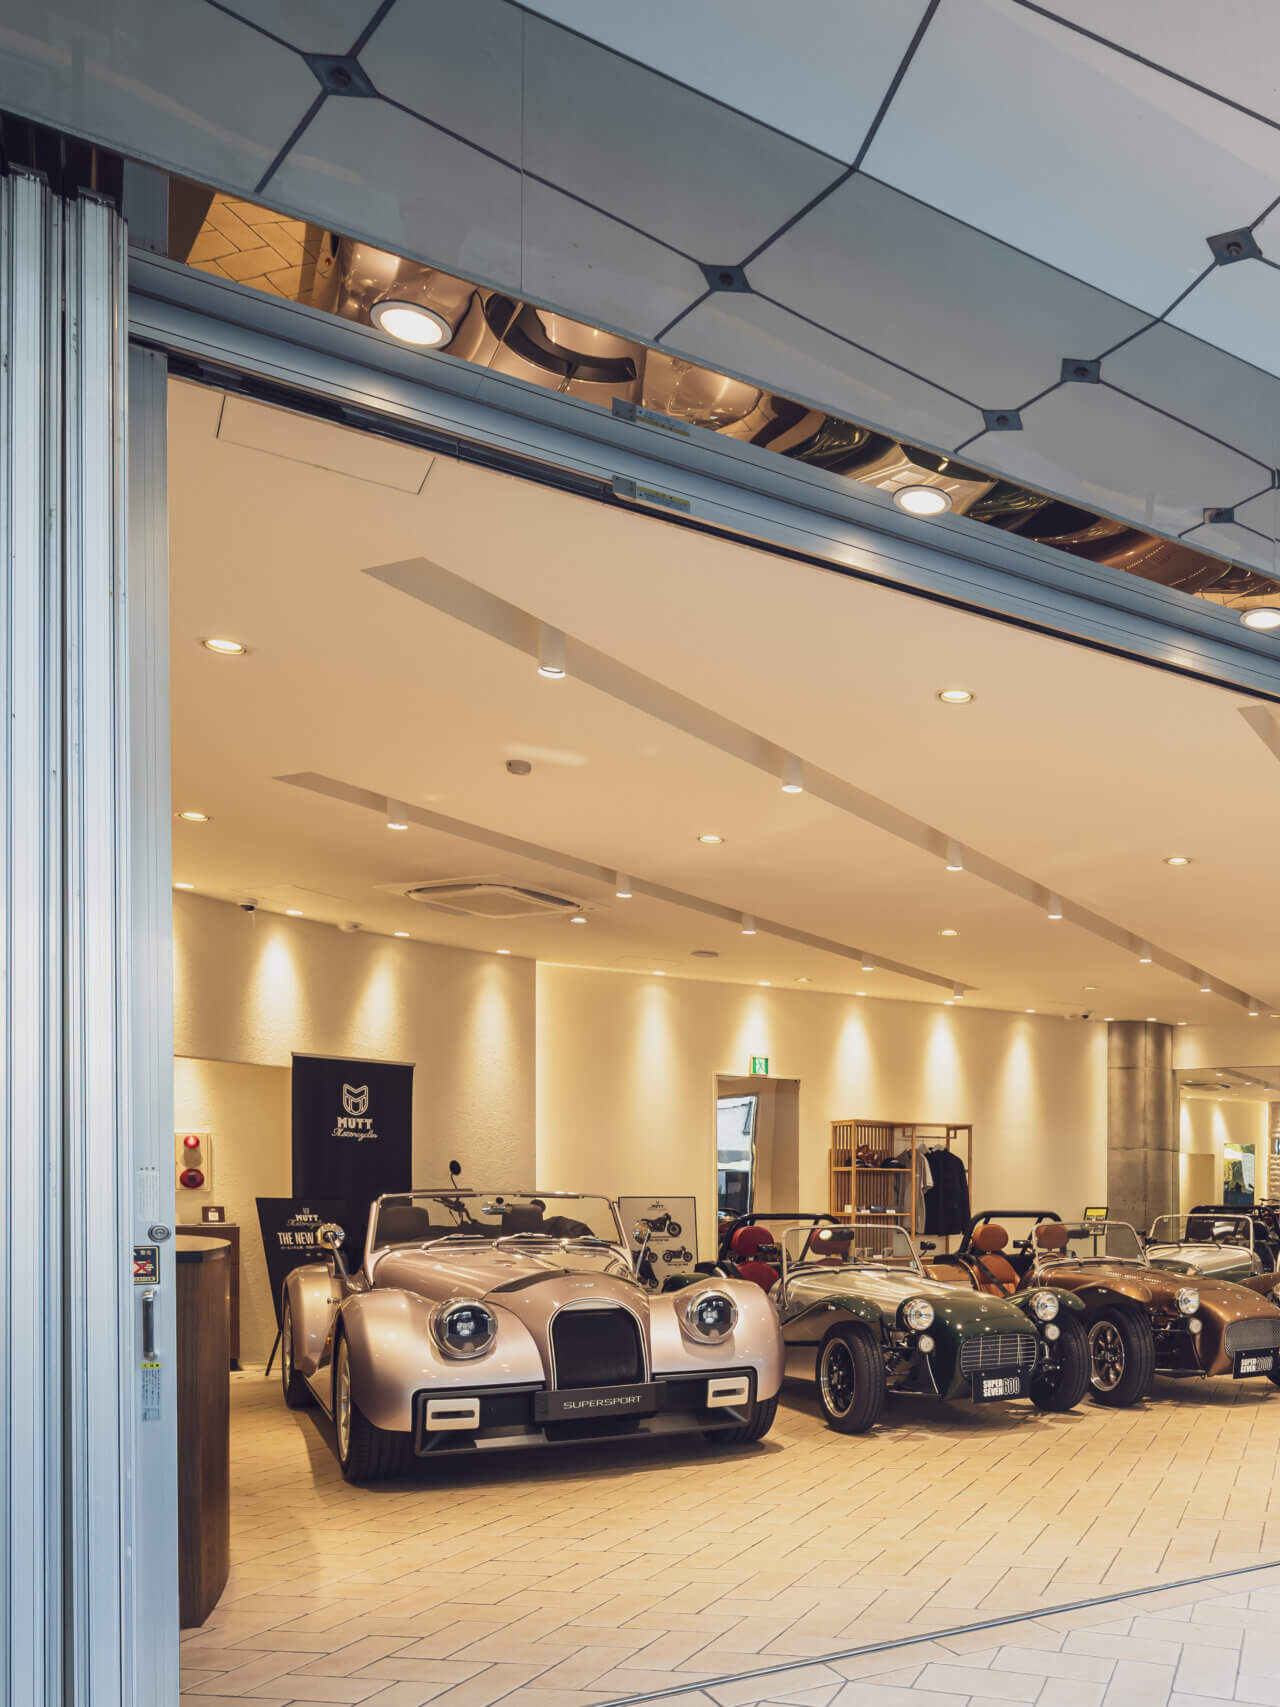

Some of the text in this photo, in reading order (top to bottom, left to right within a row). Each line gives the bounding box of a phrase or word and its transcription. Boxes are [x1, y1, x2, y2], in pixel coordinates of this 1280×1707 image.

[336, 1116, 374, 1129] MUTT
[277, 1231, 315, 1245] THE NEW
[562, 1395, 642, 1410] SUPERSPORT
